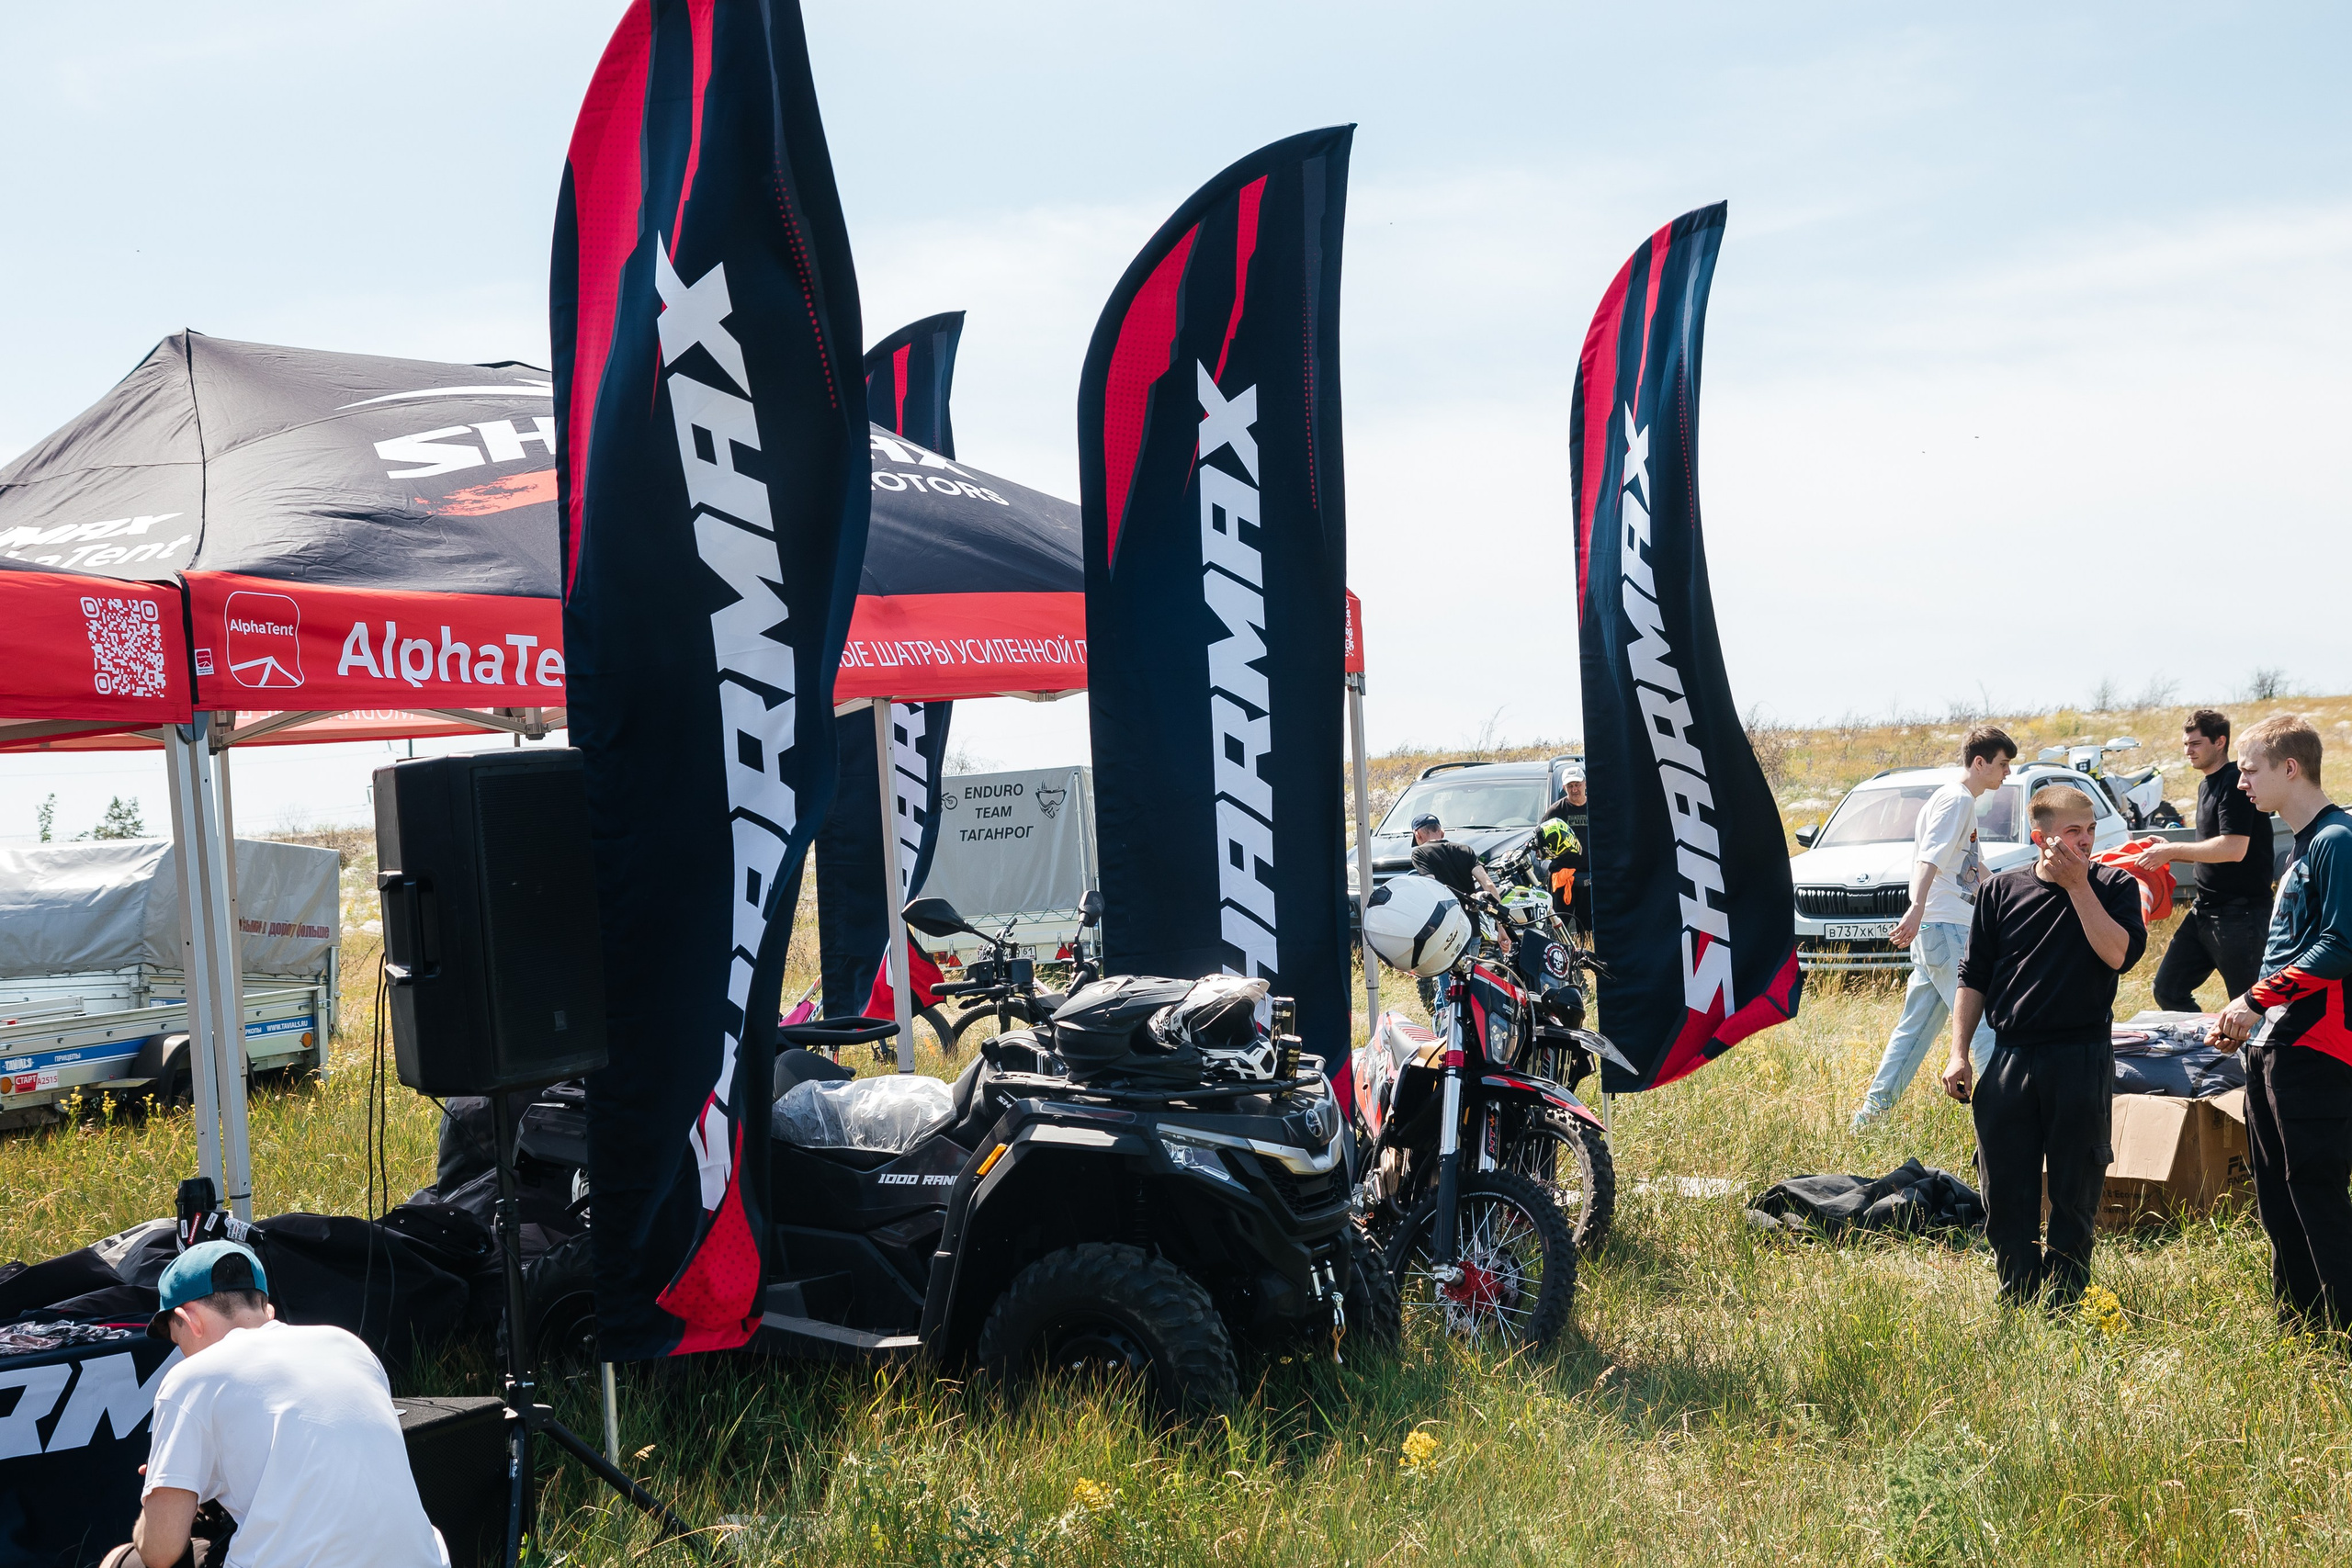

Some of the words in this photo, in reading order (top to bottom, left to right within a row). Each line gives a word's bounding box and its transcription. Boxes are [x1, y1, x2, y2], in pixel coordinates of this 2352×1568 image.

[871, 471, 1010, 505] OTORS
[0, 512, 185, 547] MAX
[230, 619, 294, 636] AlphaTent
[872, 641, 954, 666] ШАТРЫ
[949, 635, 1076, 665] УСИЛЕННОЙ
[1197, 358, 1278, 1031] HARMAX
[1622, 401, 1735, 1017] SHARMAX
[965, 784, 1023, 799] ENDURO
[975, 806, 1012, 818] TEAM
[960, 826, 1034, 841] ТАГАНРОГ
[55, 1053, 81, 1063] ПРИЦЕПЫ
[15, 1075, 37, 1086] СТАРТ
[877, 1174, 919, 1185] 1000
[922, 1174, 959, 1186] RAN
